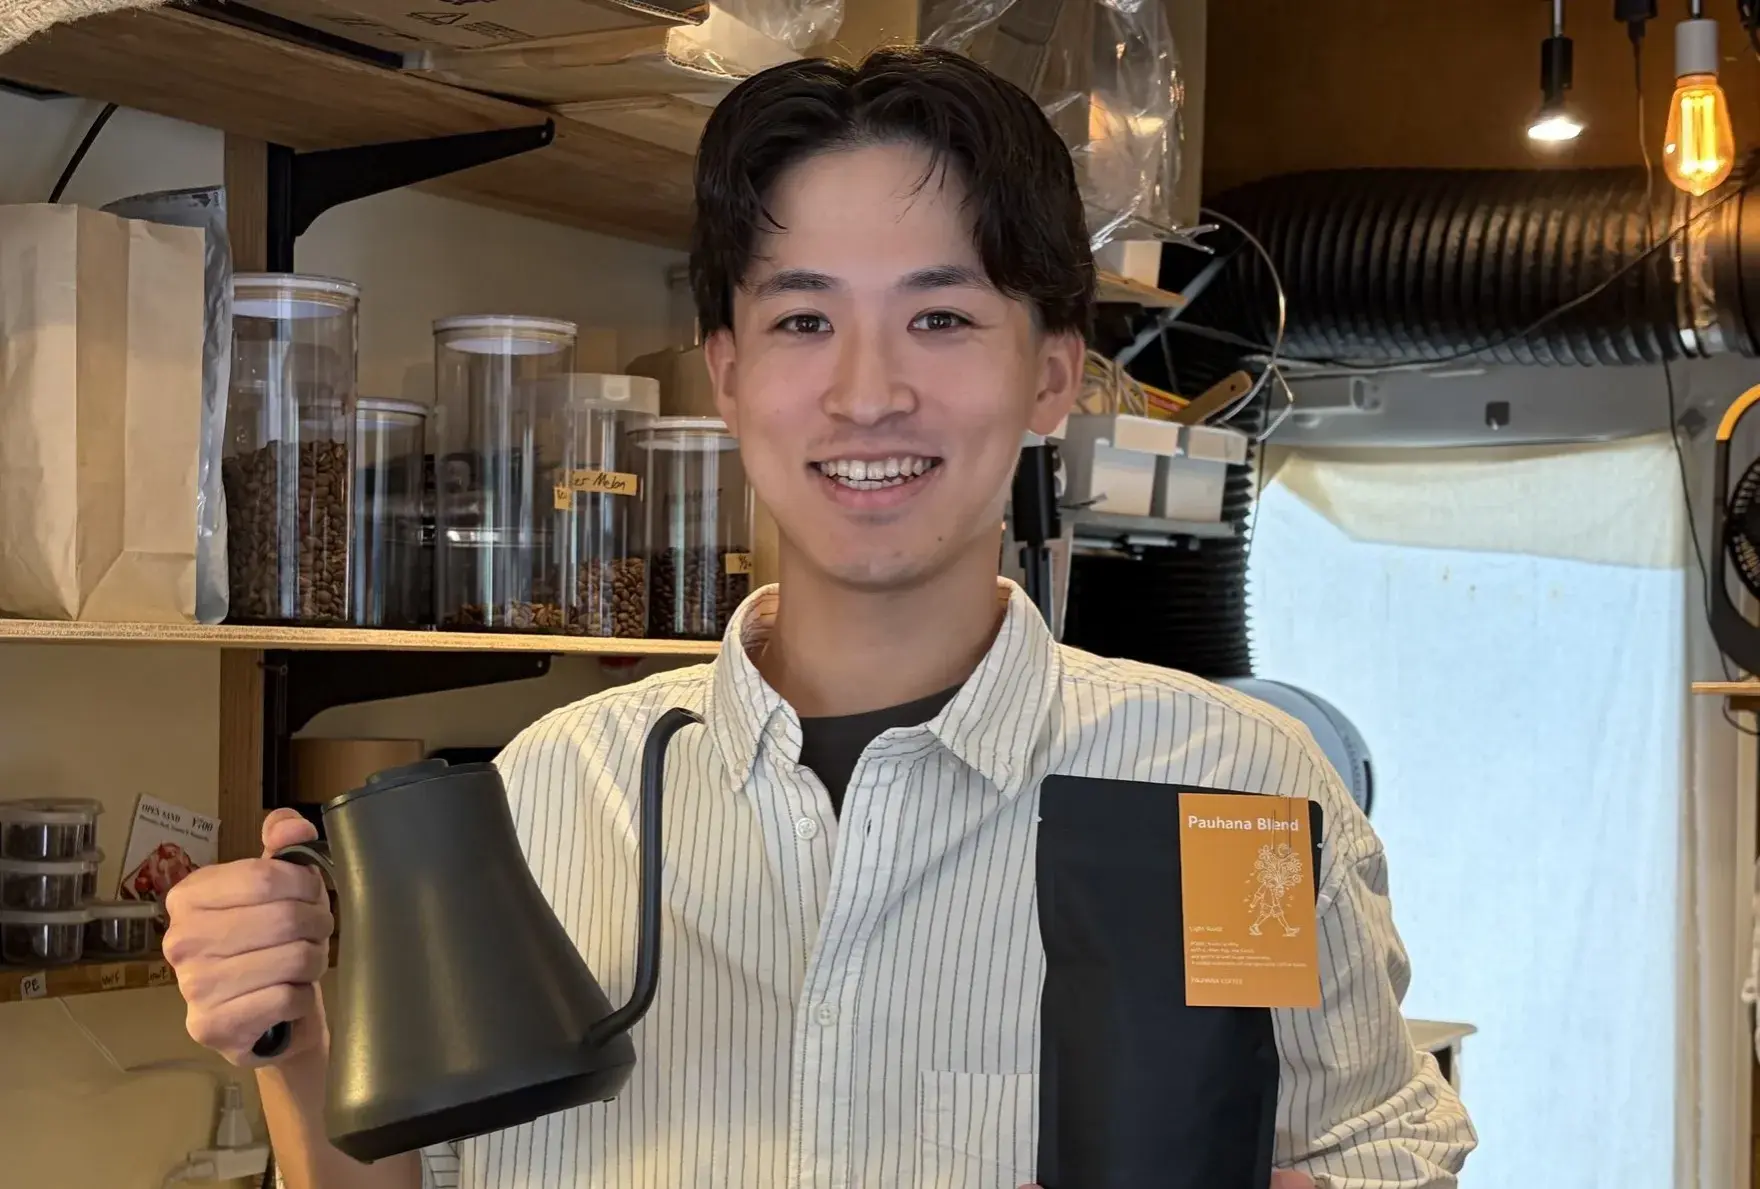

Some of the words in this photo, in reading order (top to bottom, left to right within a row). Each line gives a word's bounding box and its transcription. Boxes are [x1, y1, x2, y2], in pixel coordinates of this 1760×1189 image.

[593, 472, 626, 491] Melon
[1187, 815, 1252, 831] Pauhana
[1257, 817, 1299, 832] Blend
[24, 978, 40, 995] PE
